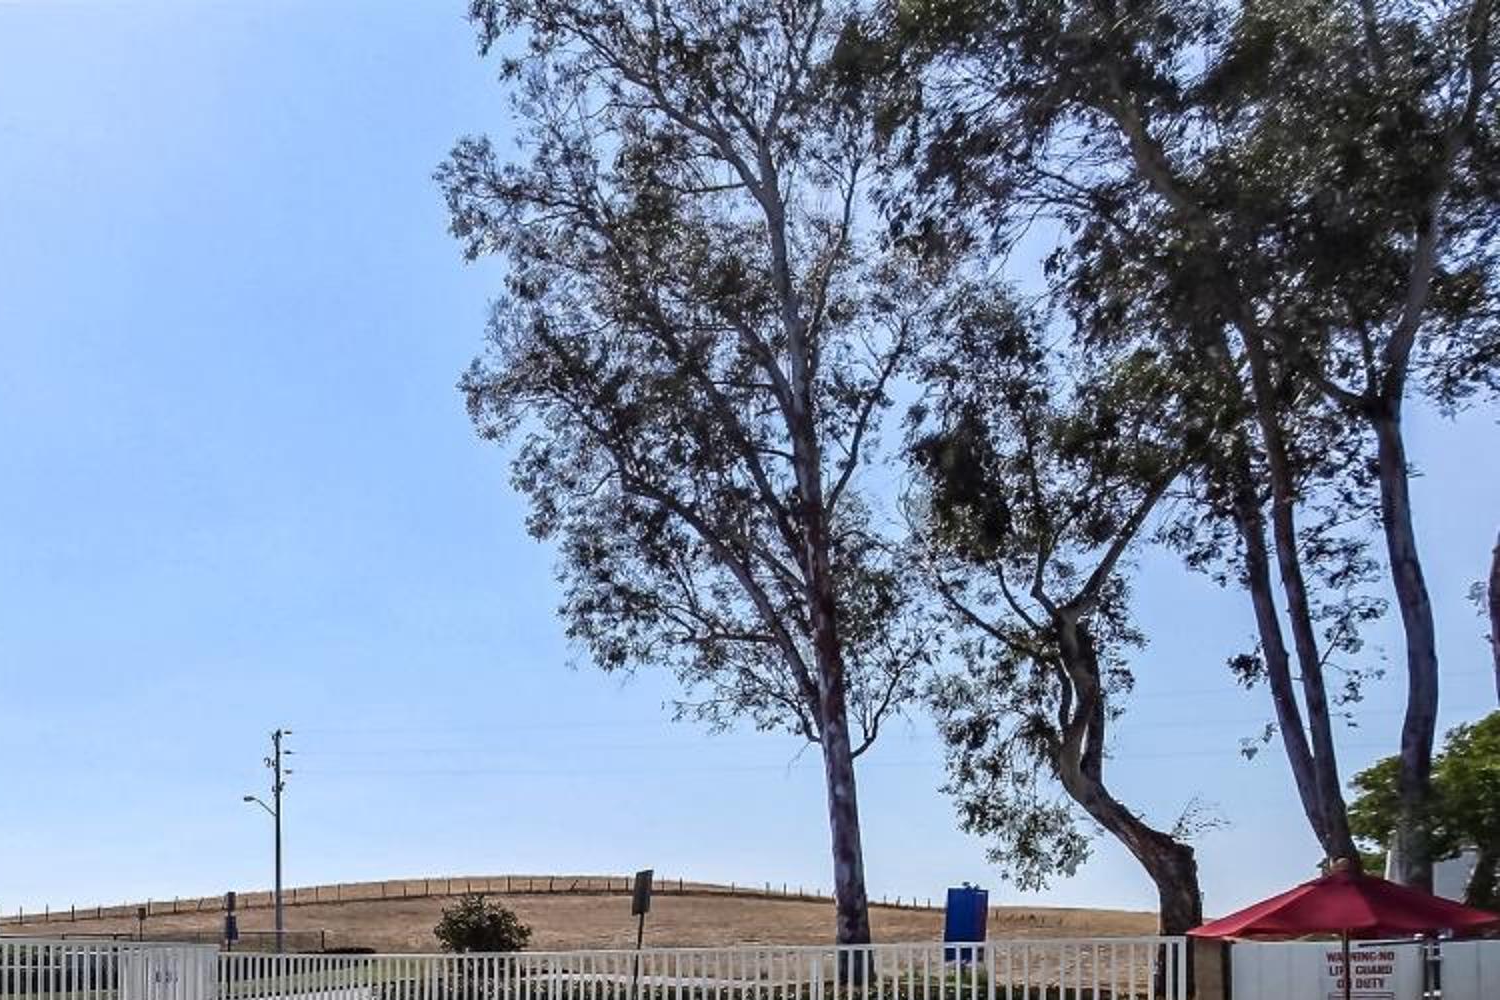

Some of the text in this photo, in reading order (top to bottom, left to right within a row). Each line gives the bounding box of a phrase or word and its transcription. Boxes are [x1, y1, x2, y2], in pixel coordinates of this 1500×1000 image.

[1329, 965, 1393, 976] LIF GUARD
[1355, 977, 1384, 989] DUTY
